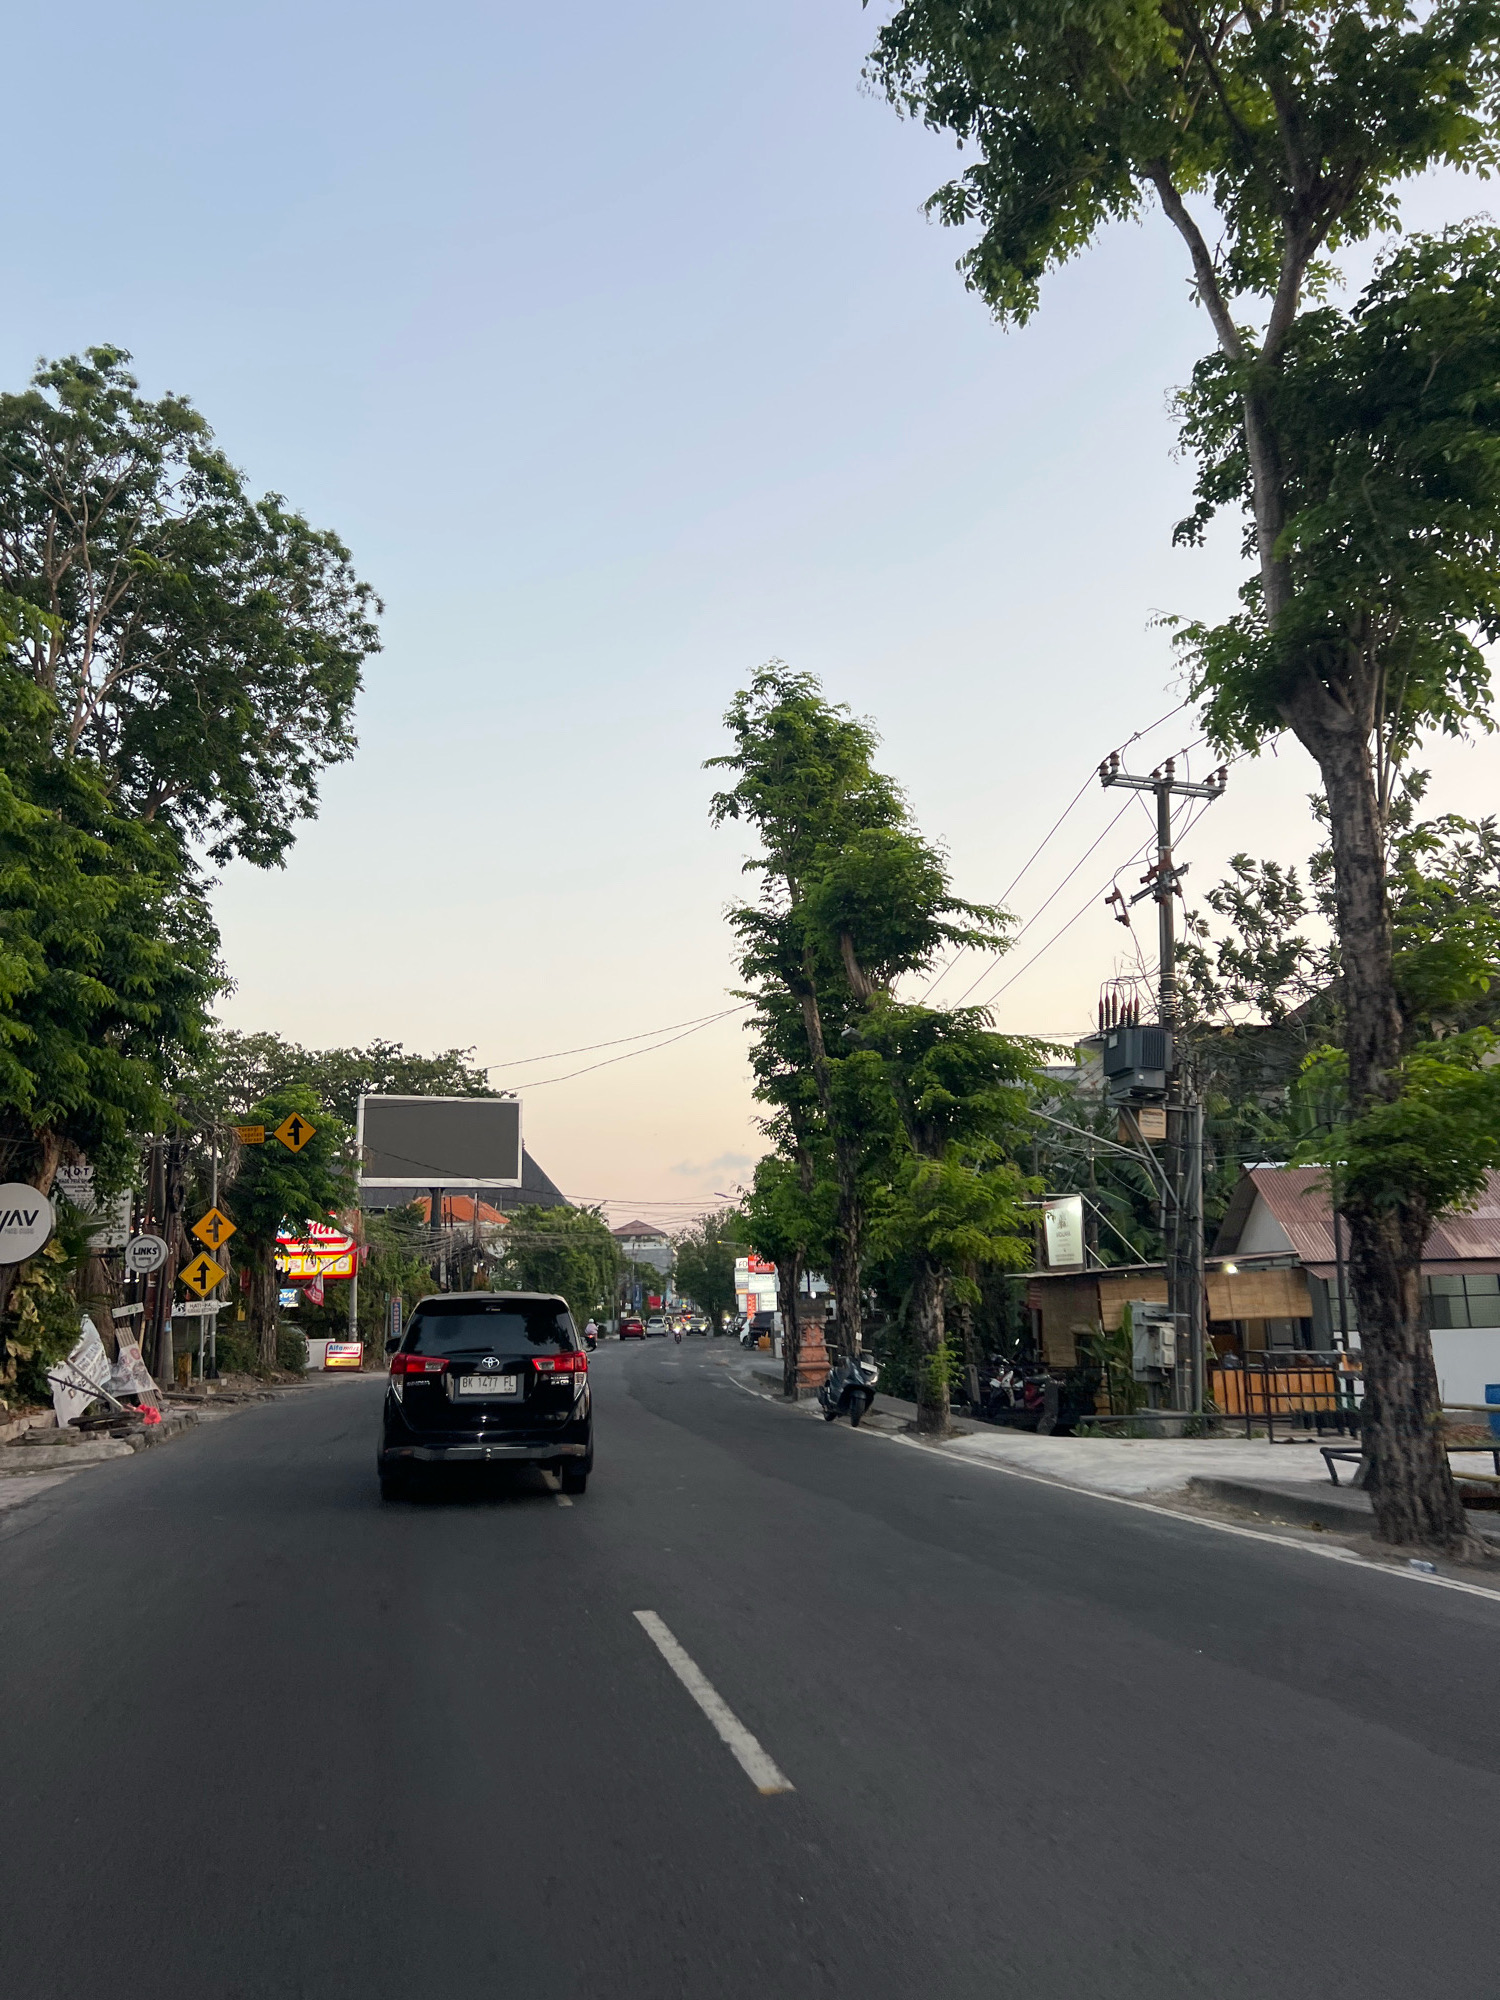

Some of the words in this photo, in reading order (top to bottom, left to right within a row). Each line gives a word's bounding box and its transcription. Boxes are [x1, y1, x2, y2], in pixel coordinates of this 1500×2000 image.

[133, 1247, 158, 1255] LINKS
[462, 1377, 473, 1388] BK
[478, 1377, 498, 1388] 1477
[503, 1376, 514, 1387] FL
